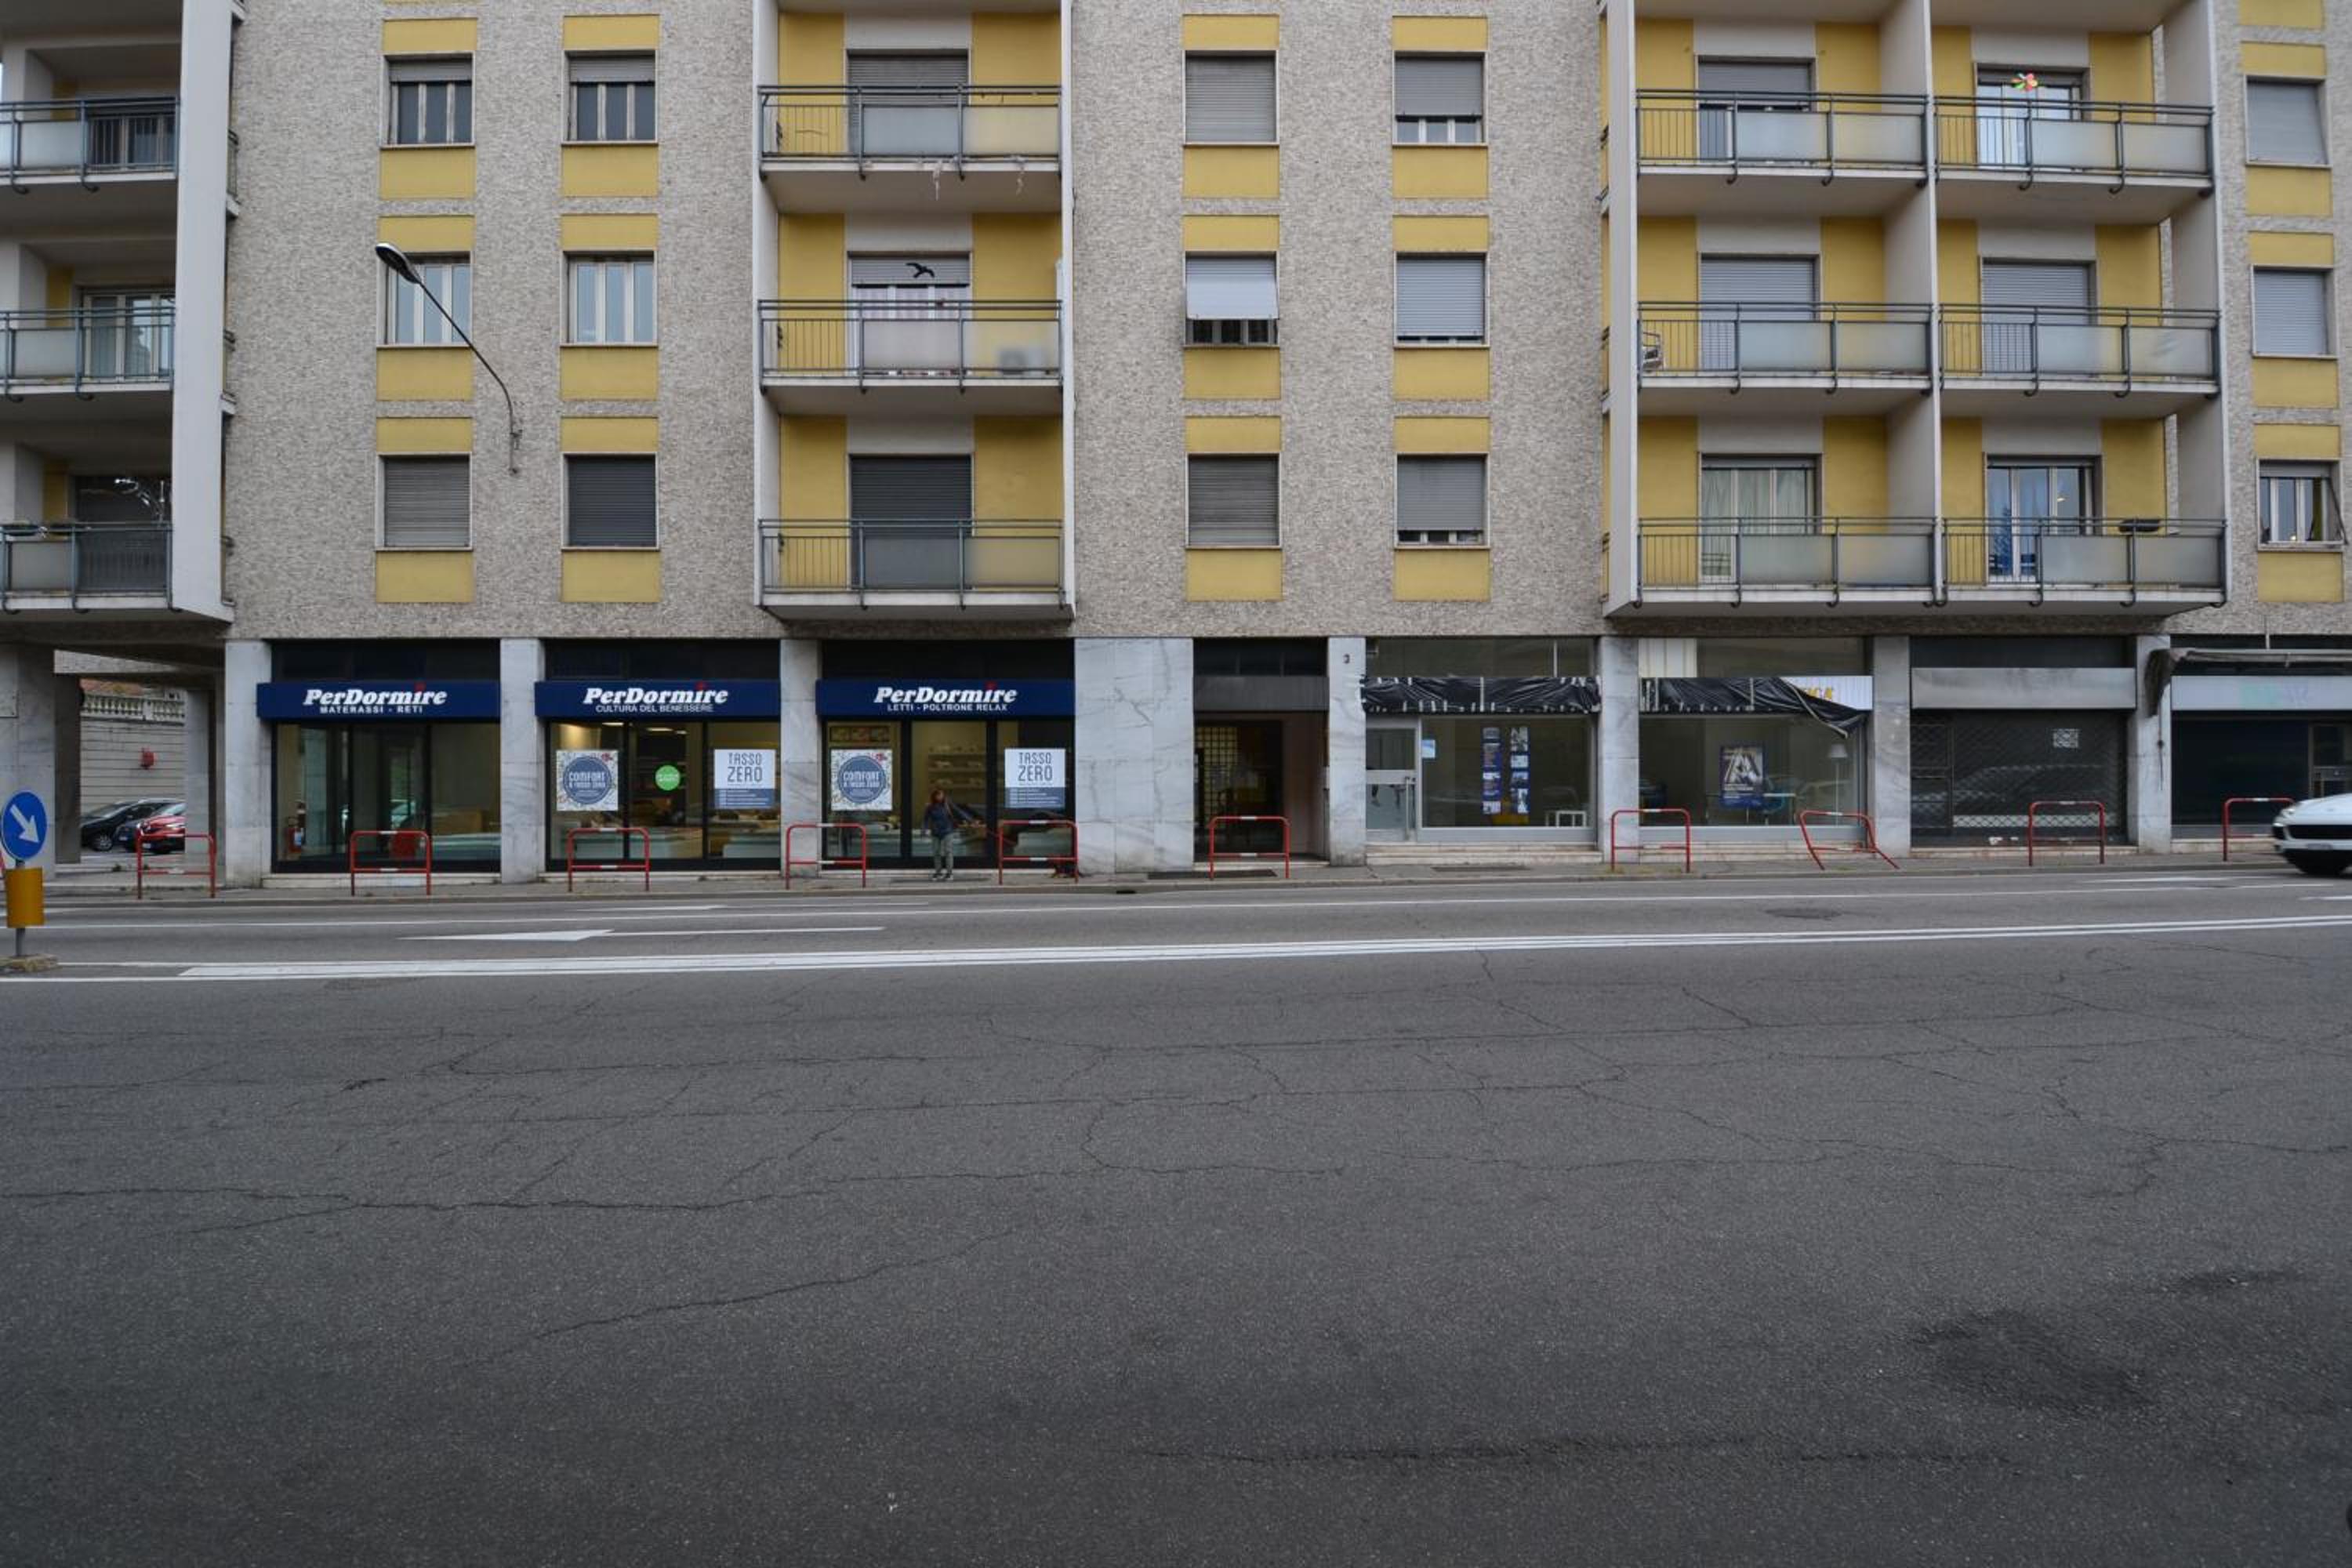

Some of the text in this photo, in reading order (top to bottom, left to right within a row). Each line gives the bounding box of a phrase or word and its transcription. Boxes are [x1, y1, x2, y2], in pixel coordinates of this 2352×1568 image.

[303, 681, 448, 706] PerDormire
[583, 681, 728, 704] PerDormire
[873, 680, 1018, 703] PerDormire
[596, 704, 713, 713] CULTURA DEL BENESSERE
[728, 752, 762, 765] TASSO
[1018, 752, 1052, 764] TASSO
[727, 766, 763, 782] ZERO
[1018, 764, 1053, 782] ZERO
